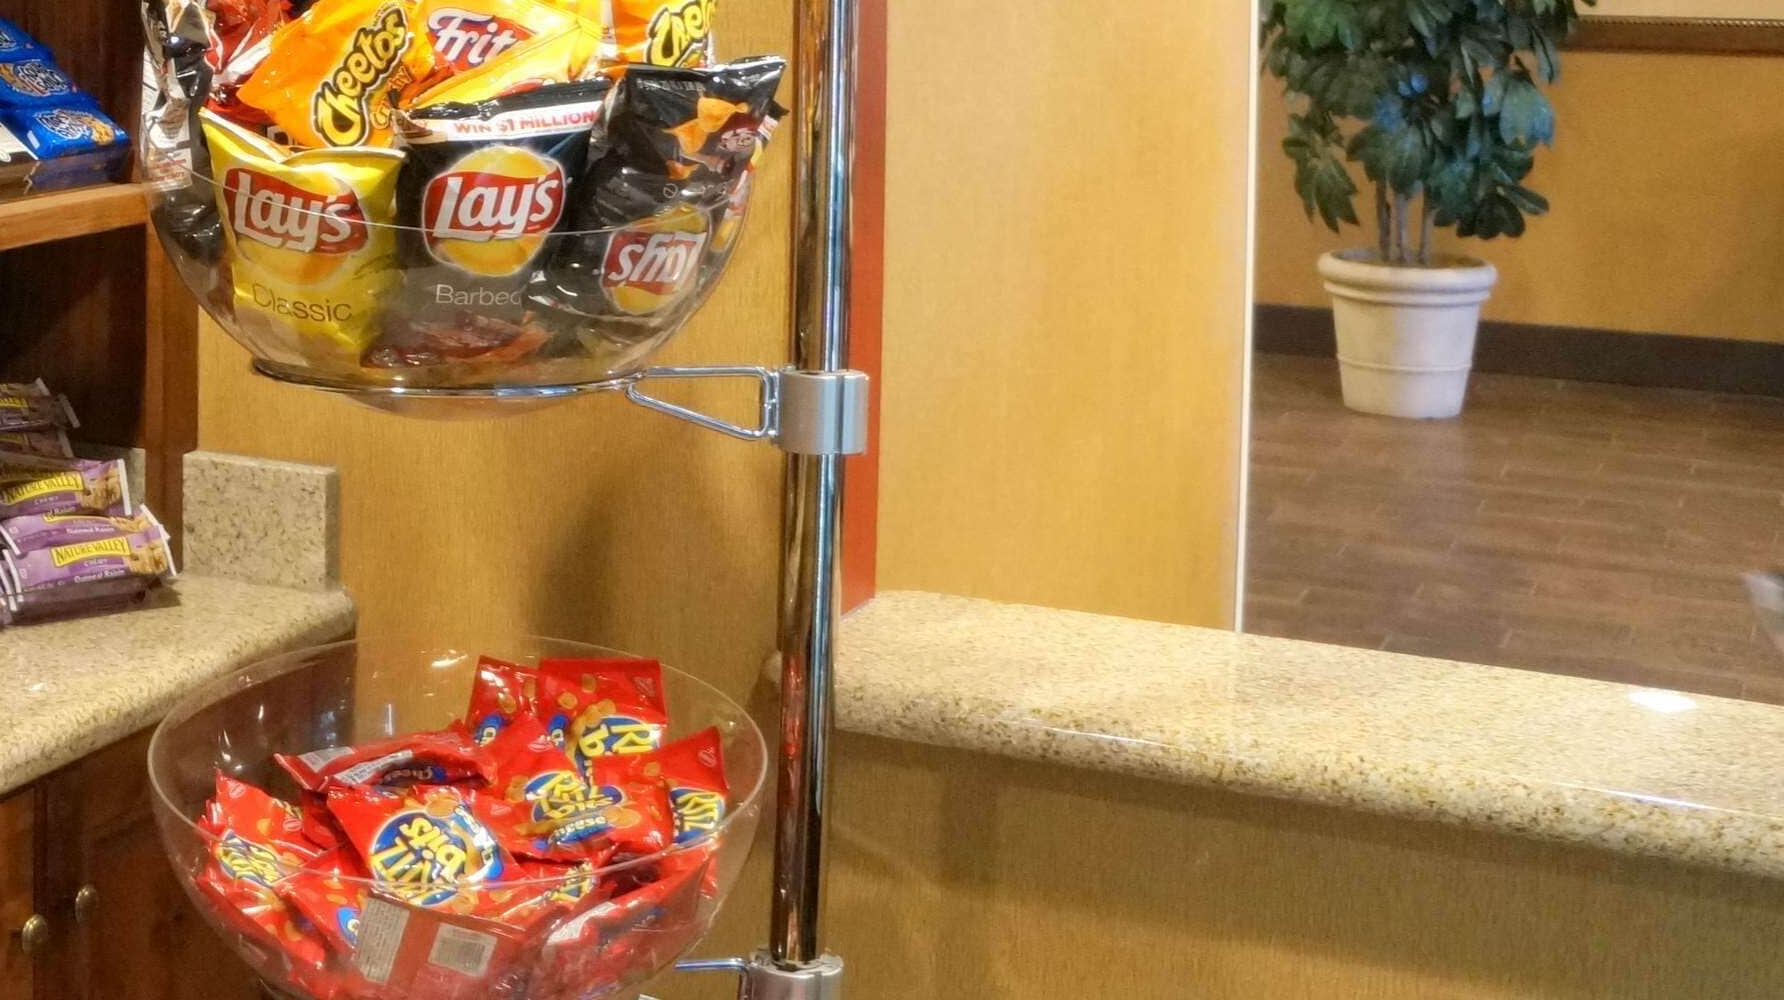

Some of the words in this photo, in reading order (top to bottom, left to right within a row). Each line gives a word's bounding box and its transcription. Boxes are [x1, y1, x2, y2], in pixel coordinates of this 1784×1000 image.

[317, 8, 408, 147] Cheetos
[453, 120, 492, 135] WIN
[498, 116, 516, 133] $1
[519, 110, 596, 132] MILLION
[234, 172, 354, 255] Lay's
[433, 165, 562, 243] Lay's
[604, 230, 703, 285] Lay's
[251, 283, 353, 323] Classic
[40, 475, 81, 491] VALLEY
[55, 545, 87, 563] NATURE
[86, 537, 127, 555] VALLEY
